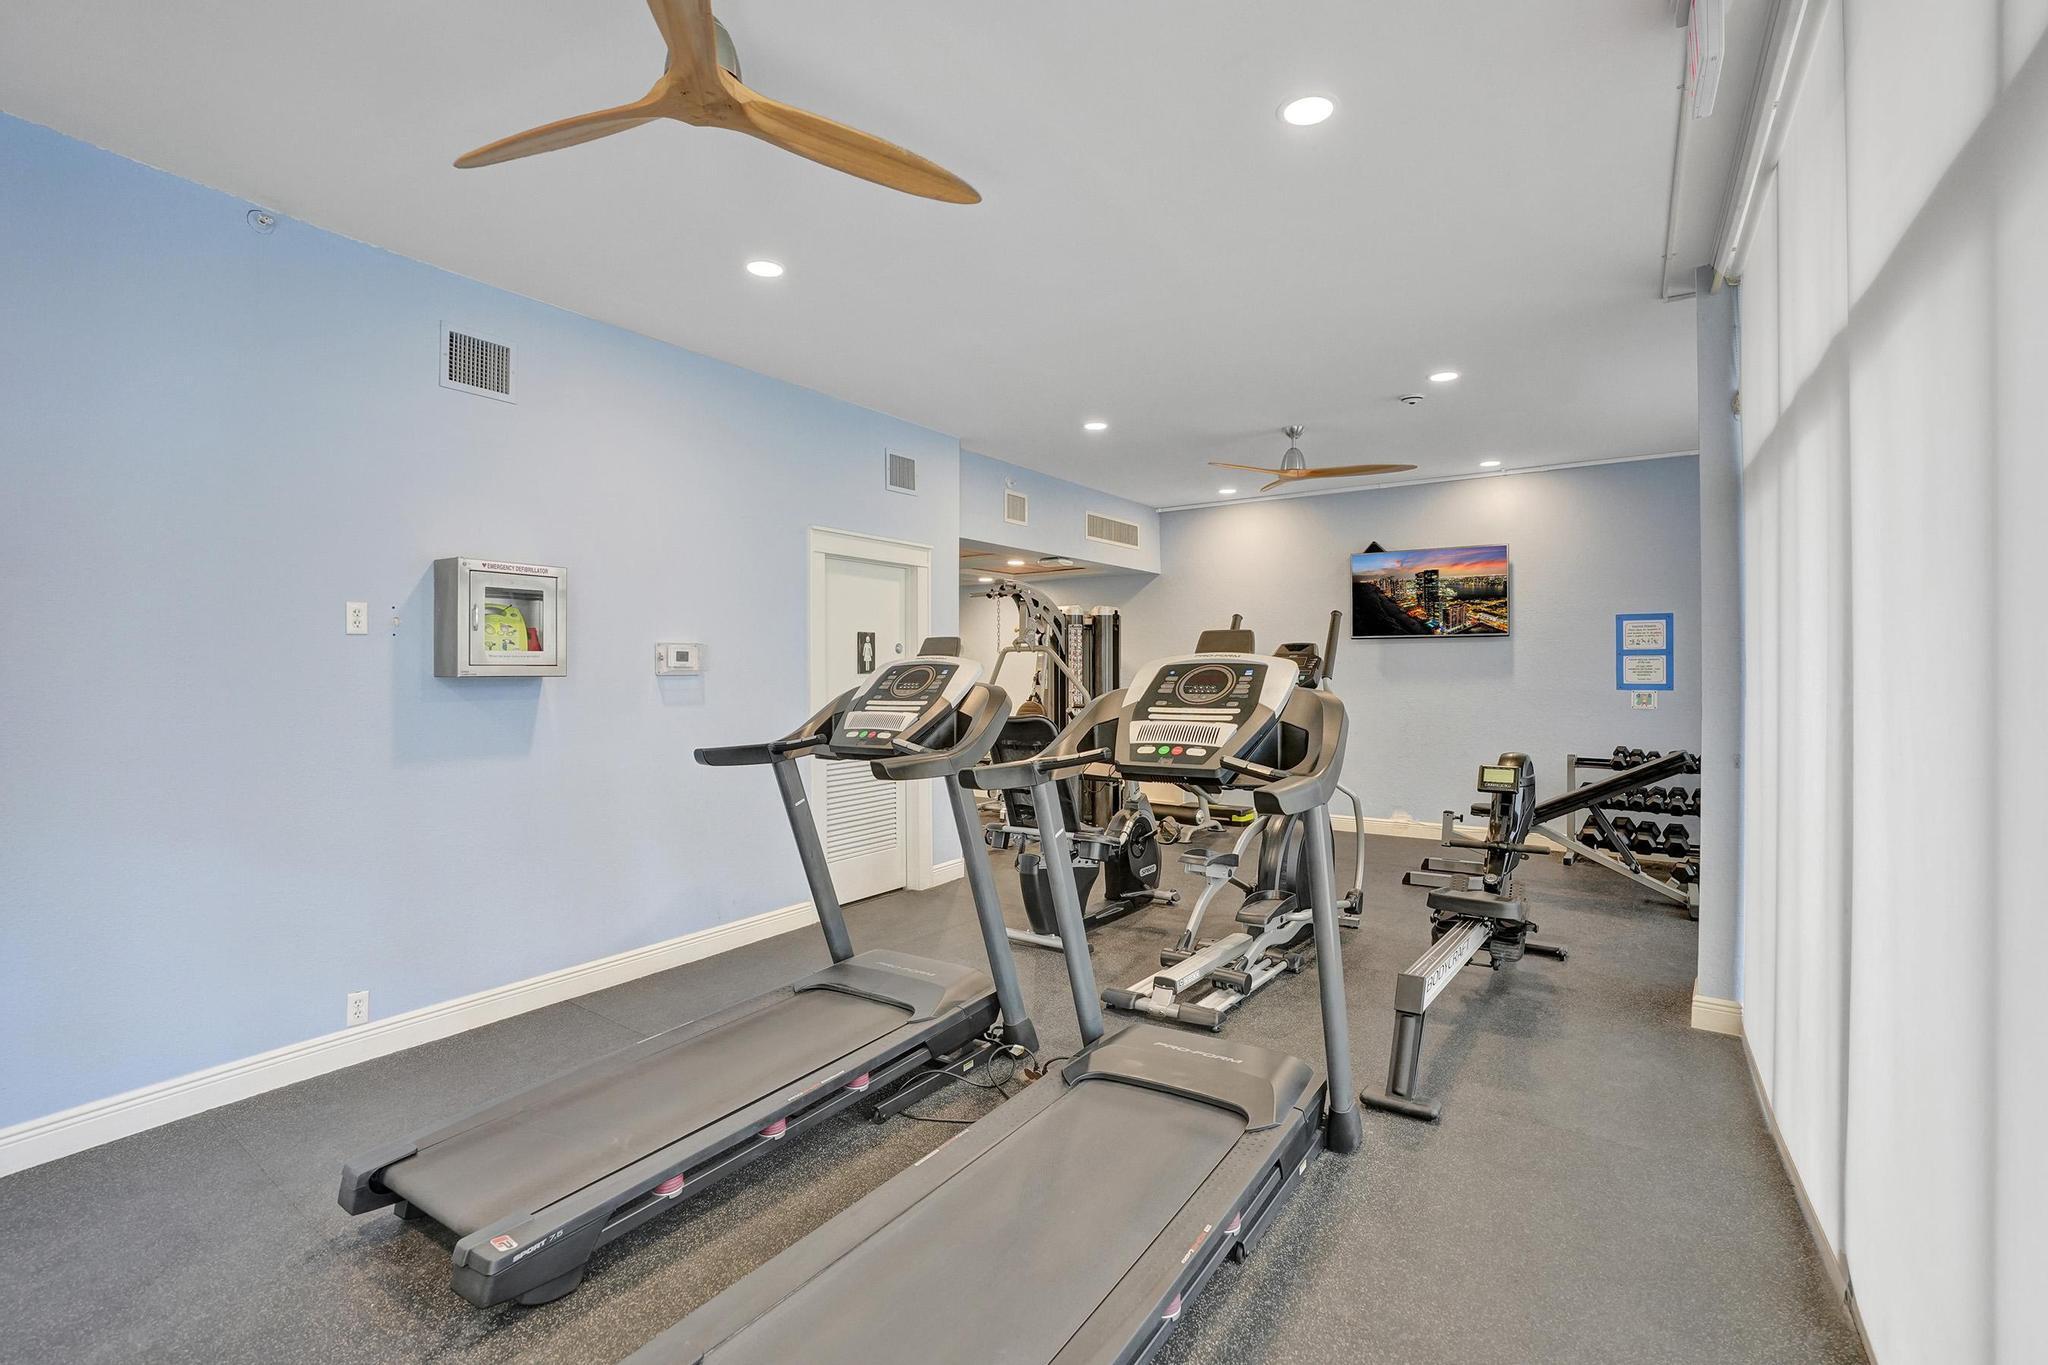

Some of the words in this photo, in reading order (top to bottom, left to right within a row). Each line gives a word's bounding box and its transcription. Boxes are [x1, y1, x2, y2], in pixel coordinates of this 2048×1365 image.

[487, 563, 515, 572] EMERGENCY
[516, 565, 549, 574] DEFIBRILLATOR
[512, 1238, 547, 1263] SPORT
